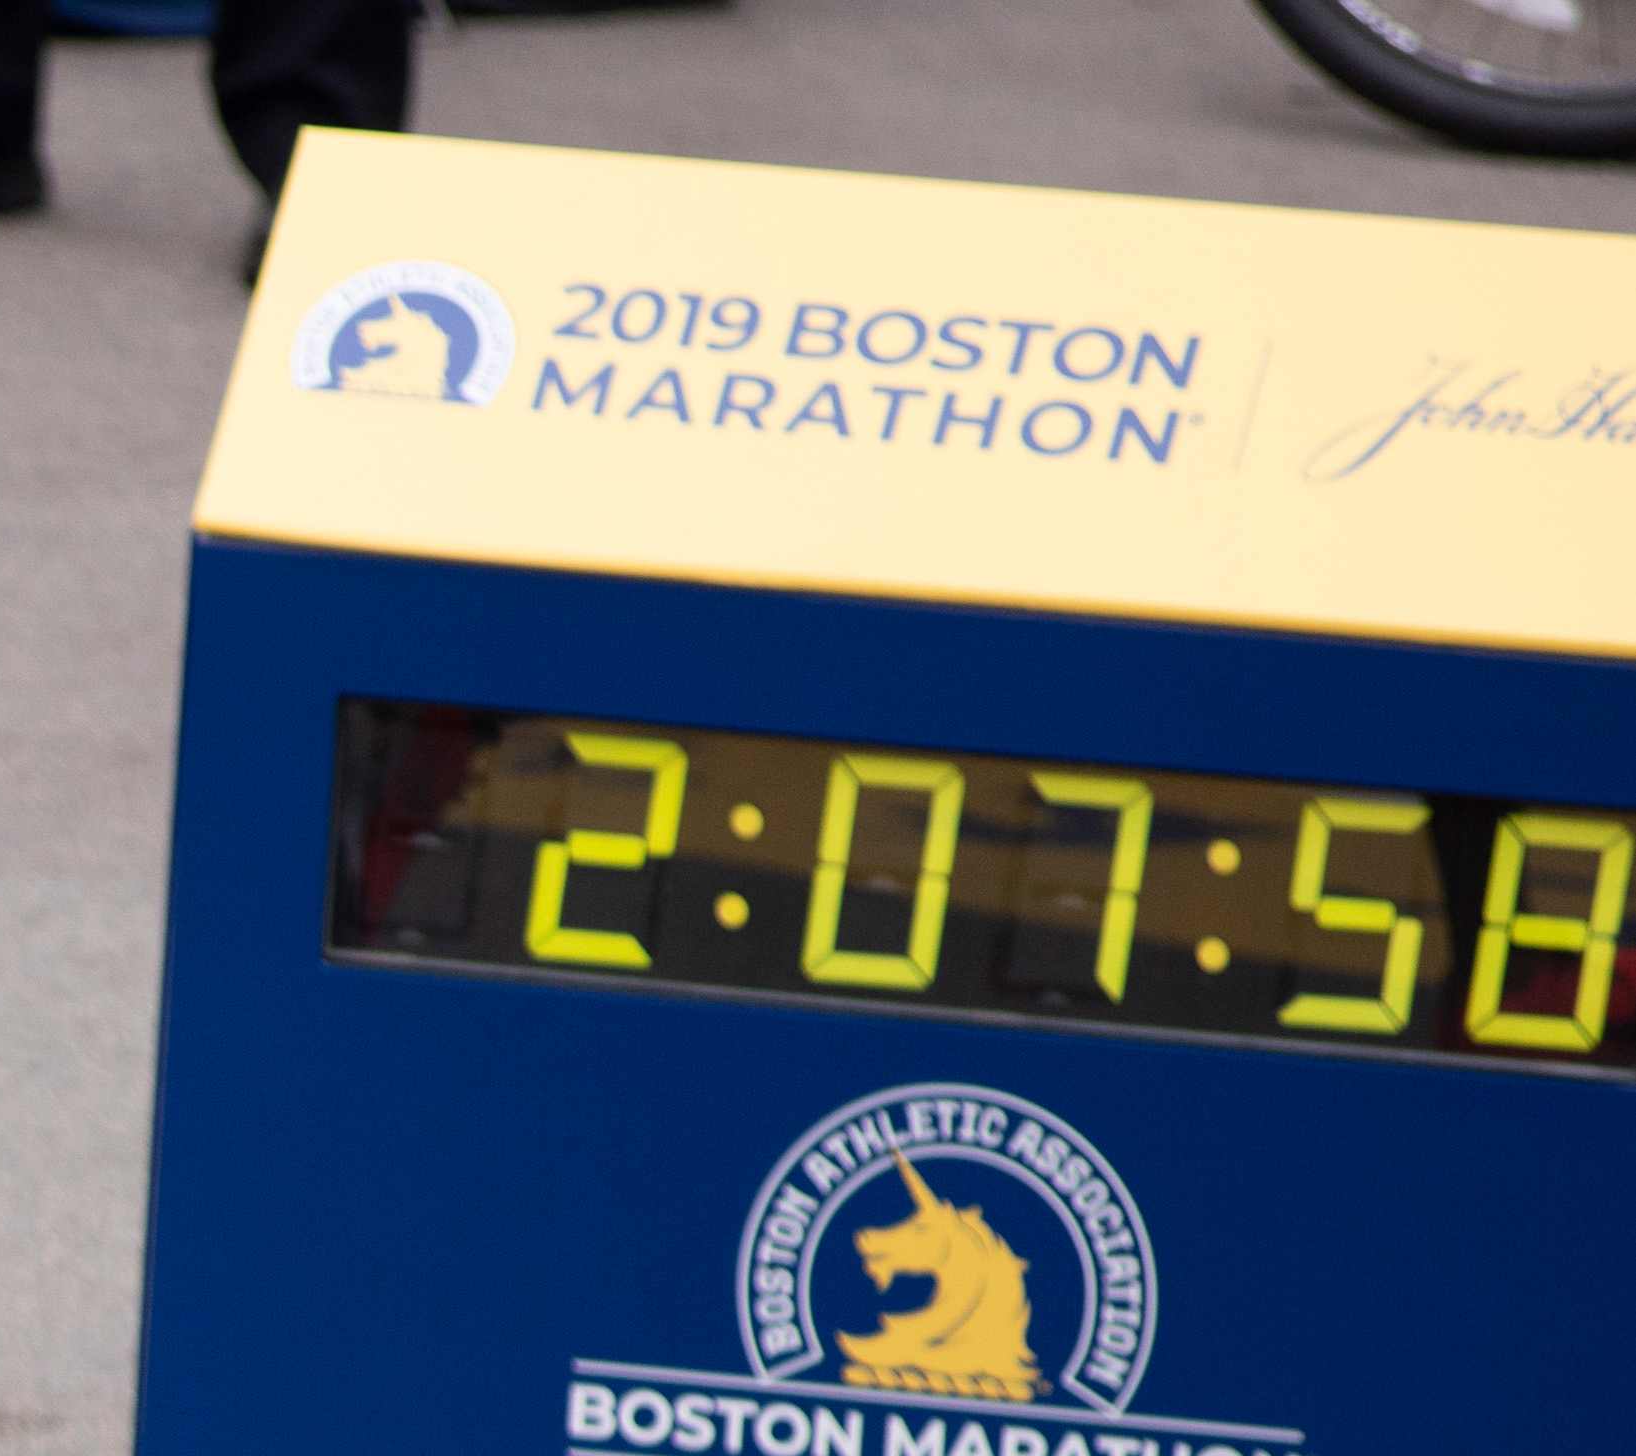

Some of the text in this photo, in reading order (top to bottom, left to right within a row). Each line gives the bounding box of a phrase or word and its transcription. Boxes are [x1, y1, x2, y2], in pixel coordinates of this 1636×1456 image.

[531, 356, 1180, 465] MARATHON
[551, 282, 763, 353] 2019
[783, 301, 1201, 391] BOSTON
[523, 730, 1633, 1053] 2:07:58
[752, 1099, 1145, 1392] BOSTON ATHLETIC ASSOCIATION
